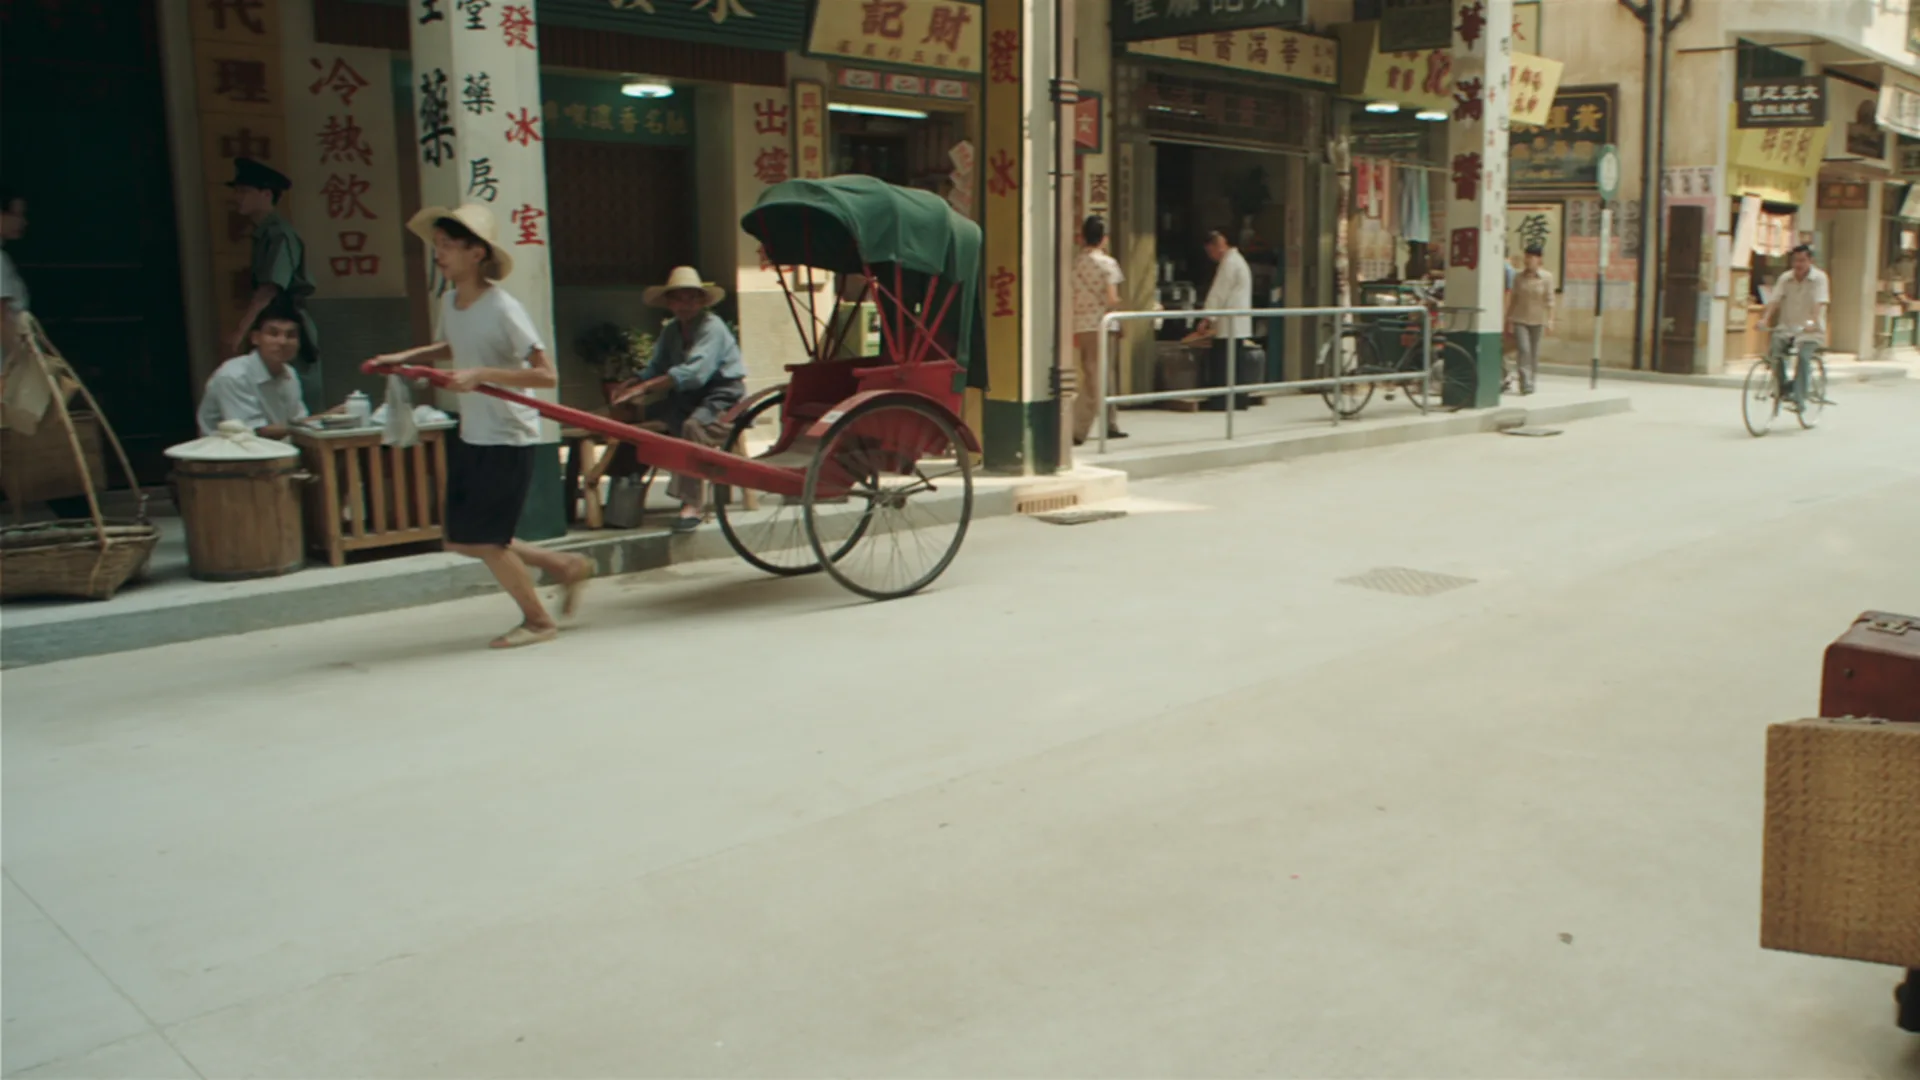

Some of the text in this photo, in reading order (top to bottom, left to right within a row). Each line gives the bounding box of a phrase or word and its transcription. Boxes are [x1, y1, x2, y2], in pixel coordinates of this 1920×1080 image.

[308, 56, 380, 277] 冷熱飲品
[499, 4, 545, 246] 發冰室
[988, 30, 1019, 318] 發冰室
